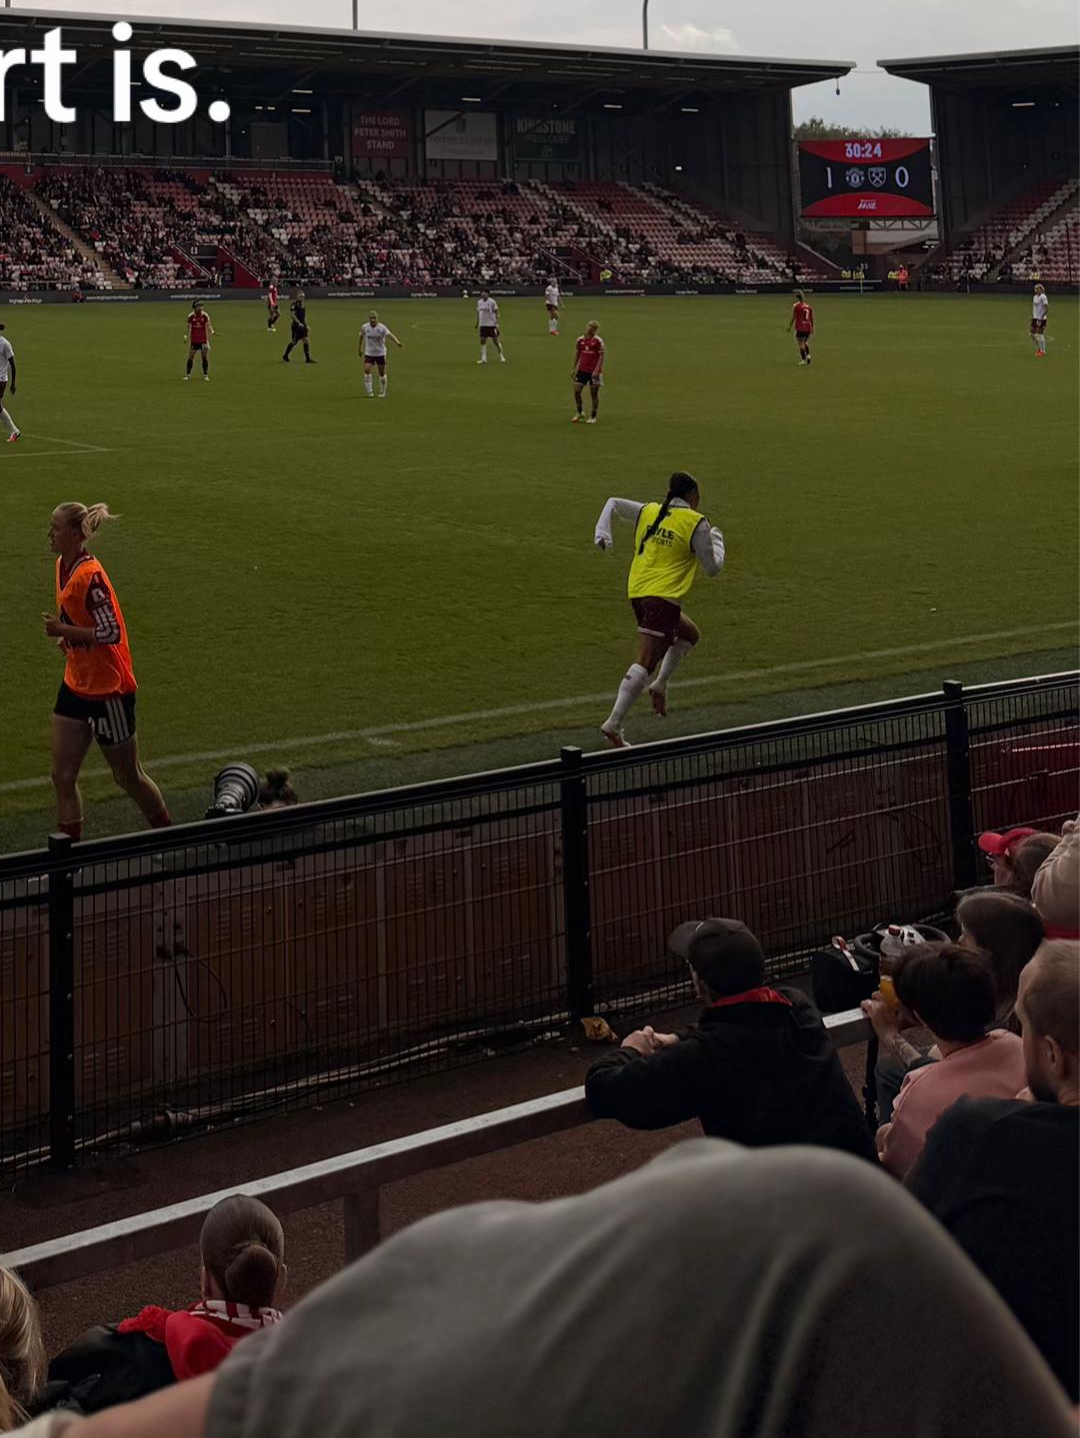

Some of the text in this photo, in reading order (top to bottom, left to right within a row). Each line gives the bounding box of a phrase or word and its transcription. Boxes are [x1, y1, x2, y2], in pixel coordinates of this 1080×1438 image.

[360, 115, 400, 127] THE LORD
[516, 117, 576, 135] KINGSTONE
[366, 139, 395, 150] STAND
[845, 142, 882, 158] 30:24
[826, 166, 910, 189] 1 0
